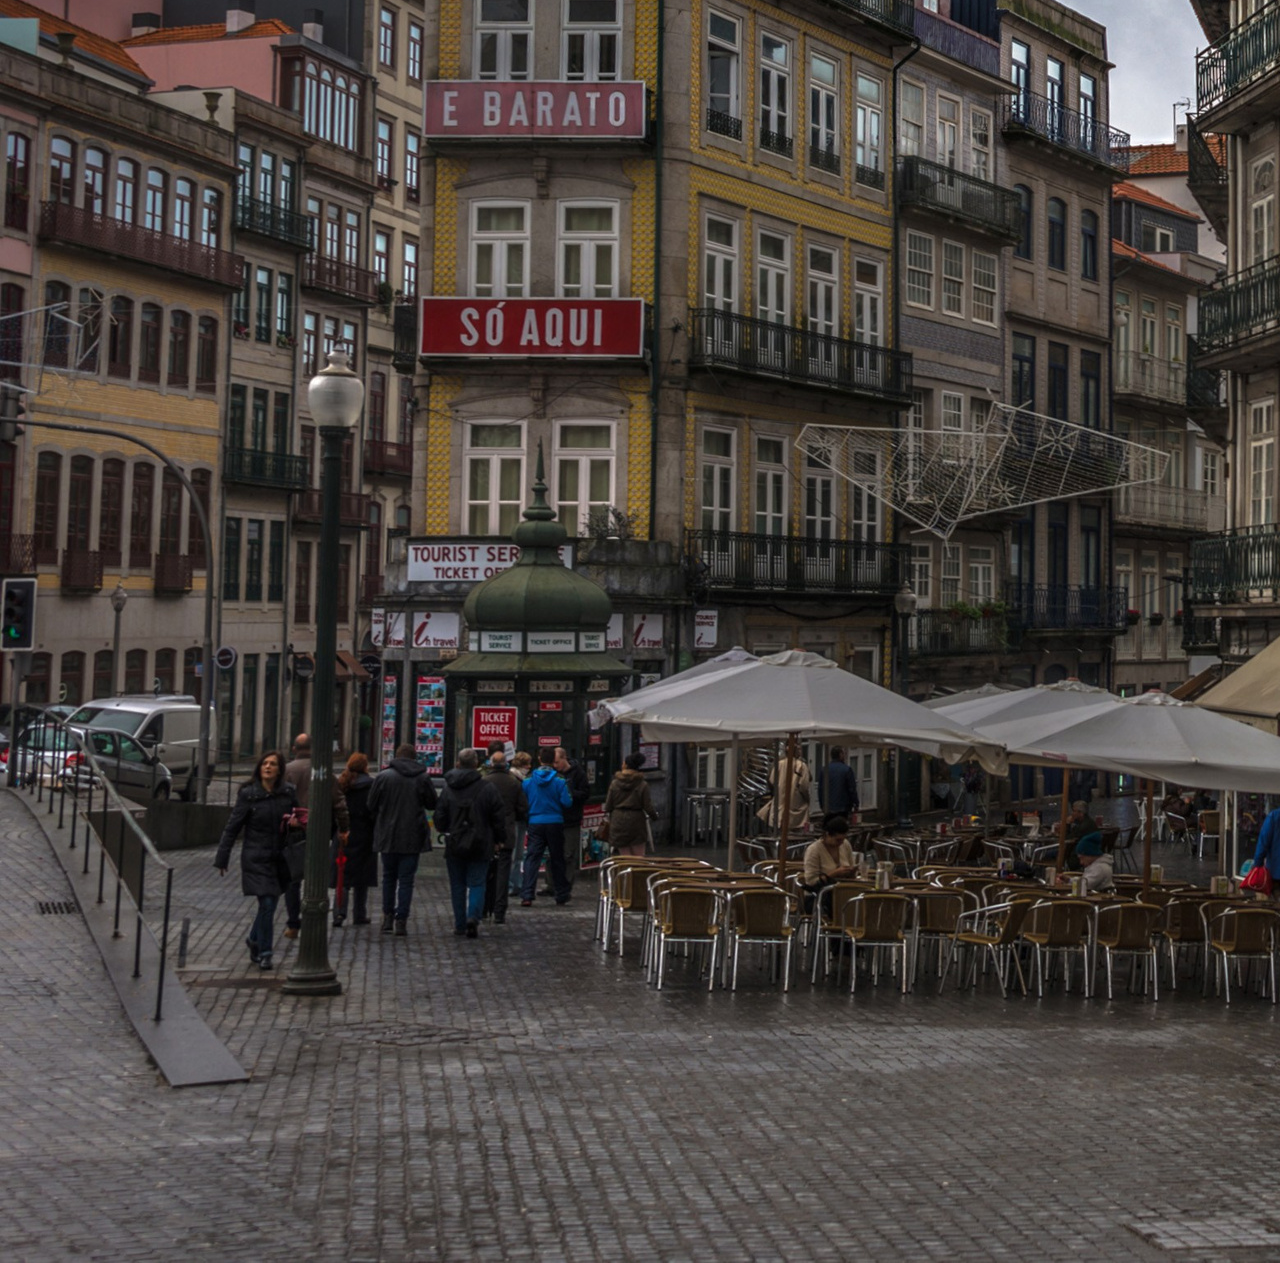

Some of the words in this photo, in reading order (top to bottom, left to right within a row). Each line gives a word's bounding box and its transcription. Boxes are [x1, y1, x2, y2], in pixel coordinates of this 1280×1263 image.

[443, 91, 458, 126] E
[483, 91, 626, 127] BARATO
[460, 302, 506, 346] SÓ
[519, 308, 603, 347] AQUI
[412, 546, 479, 563] TOURIST
[434, 567, 479, 579] TICKET
[433, 637, 457, 646] travel
[480, 712, 510, 723] TICKET
[479, 724, 510, 735] OFFICE
